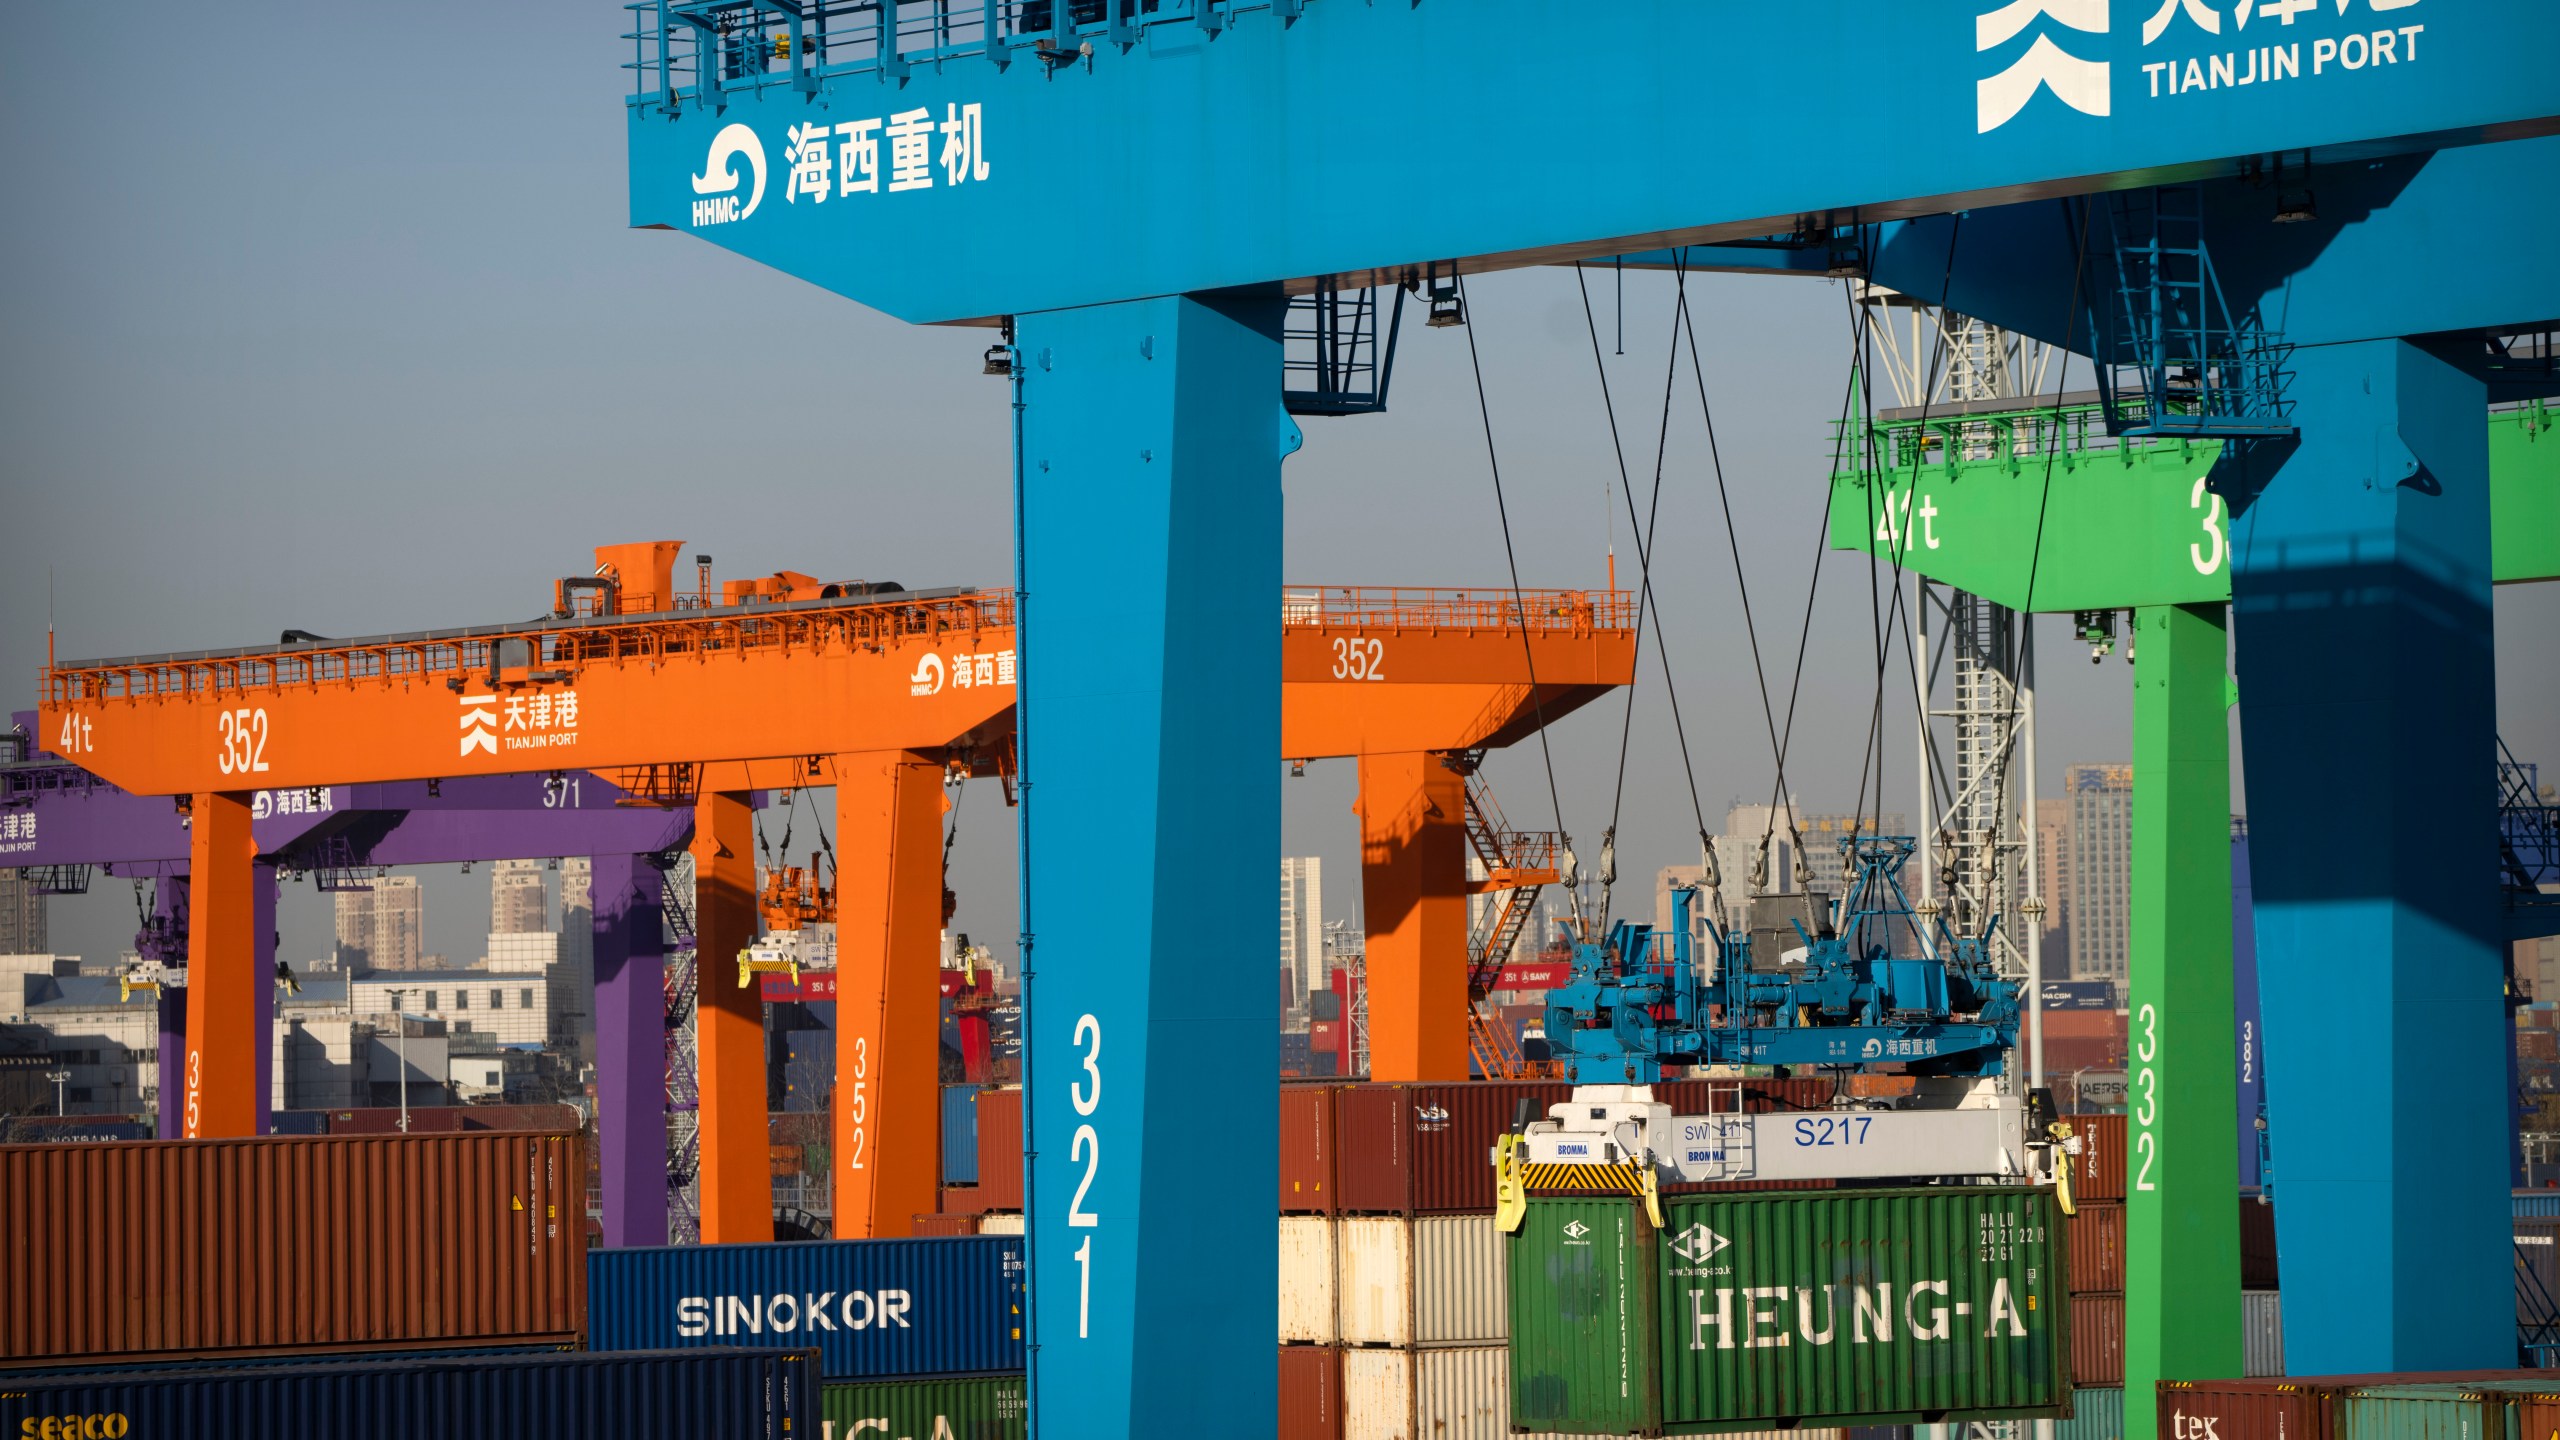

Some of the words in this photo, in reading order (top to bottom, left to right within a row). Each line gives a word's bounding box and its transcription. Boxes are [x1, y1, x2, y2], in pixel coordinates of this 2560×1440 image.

[2142, 43, 2298, 98] TIANJIN
[2313, 25, 2424, 75] PORT
[784, 102, 990, 204] 海西重机
[692, 195, 740, 227] HHMC
[1876, 489, 1940, 552] 41t
[2190, 476, 2232, 575] 3
[1332, 637, 1385, 681] 352
[911, 684, 933, 697] HHMC
[504, 690, 578, 732] 天津港
[60, 712, 94, 753] 41t
[218, 707, 270, 775] 352
[505, 735, 547, 750] TIANJIN
[549, 732, 578, 747] PORT
[543, 777, 581, 809] 371
[0, 812, 37, 840] 津港
[17, 841, 37, 852] PORT
[811, 982, 824, 992] 35t
[1504, 973, 1517, 982] 35t
[1530, 972, 1551, 981] SANY
[1753, 1046, 1767, 1056] 41T
[1886, 1039, 1938, 1056] 海西重机
[2243, 1020, 2252, 1083] 382
[187, 1050, 200, 1139] 35
[852, 1037, 866, 1169] 352
[2079, 1082, 2128, 1095] AERSK
[2136, 1003, 2156, 1191] 332
[1558, 1144, 1588, 1155] BROMMA
[1795, 1116, 1873, 1147] S217
[2087, 1124, 2098, 1178] TRITON
[1069, 1013, 1101, 1339] 321
[1981, 1212, 2014, 1228] HALU
[676, 1289, 912, 1337] SINOKOR
[1688, 1277, 2028, 1350] HEUNG-A
[21, 1412, 129, 1440] seaco
[2173, 1408, 2220, 1440] tex
